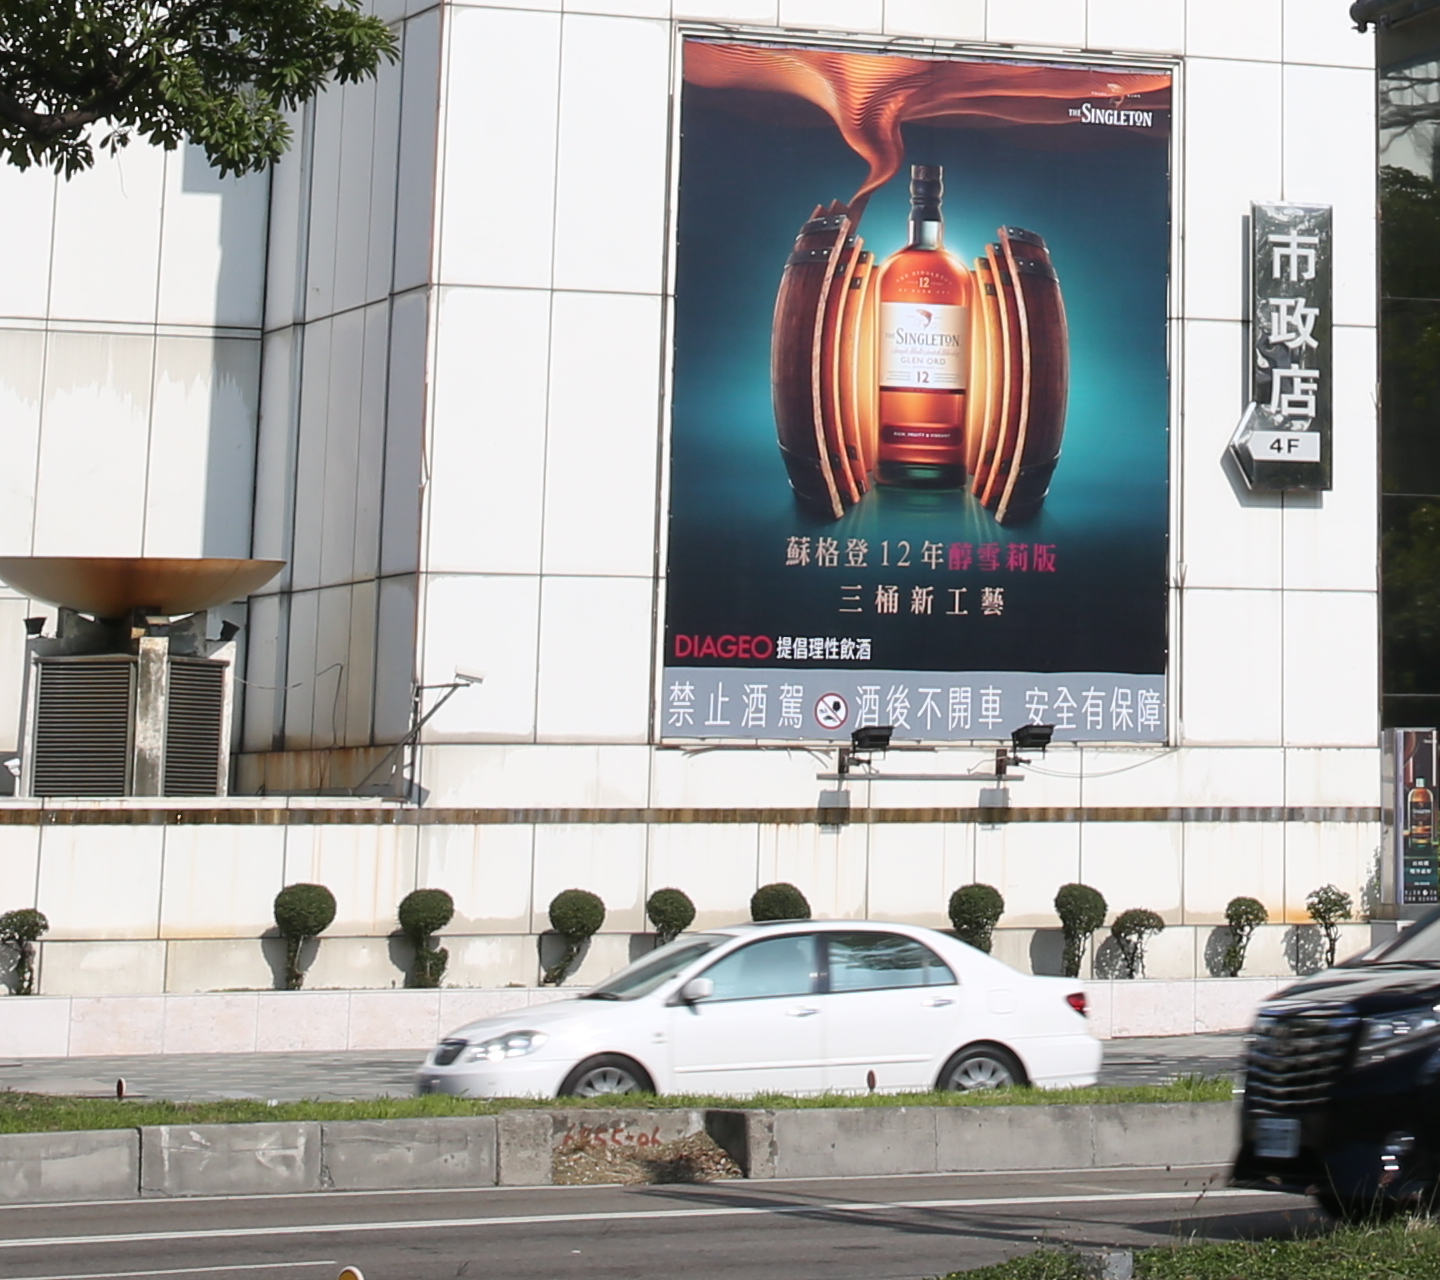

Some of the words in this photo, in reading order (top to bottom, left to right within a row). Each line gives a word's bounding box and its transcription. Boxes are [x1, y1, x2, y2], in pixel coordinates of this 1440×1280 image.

[1081, 102, 1153, 127] SINGLETON
[919, 277, 930, 288] 12
[1267, 230, 1320, 418] 市政店
[896, 327, 961, 347] SINGLETON
[901, 356, 924, 364] GLEN
[926, 357, 947, 365] ORD
[917, 371, 929, 383] 12
[1269, 438, 1300, 454] 4F
[839, 584, 1005, 616] 三桶新工藝
[674, 634, 773, 659] DIAGEO
[776, 636, 872, 661] 提倡理性飲酒
[667, 680, 804, 729] 禁止酒駕
[854, 684, 1003, 731] 酒後不開車
[1025, 685, 1161, 732] 安全有保障
